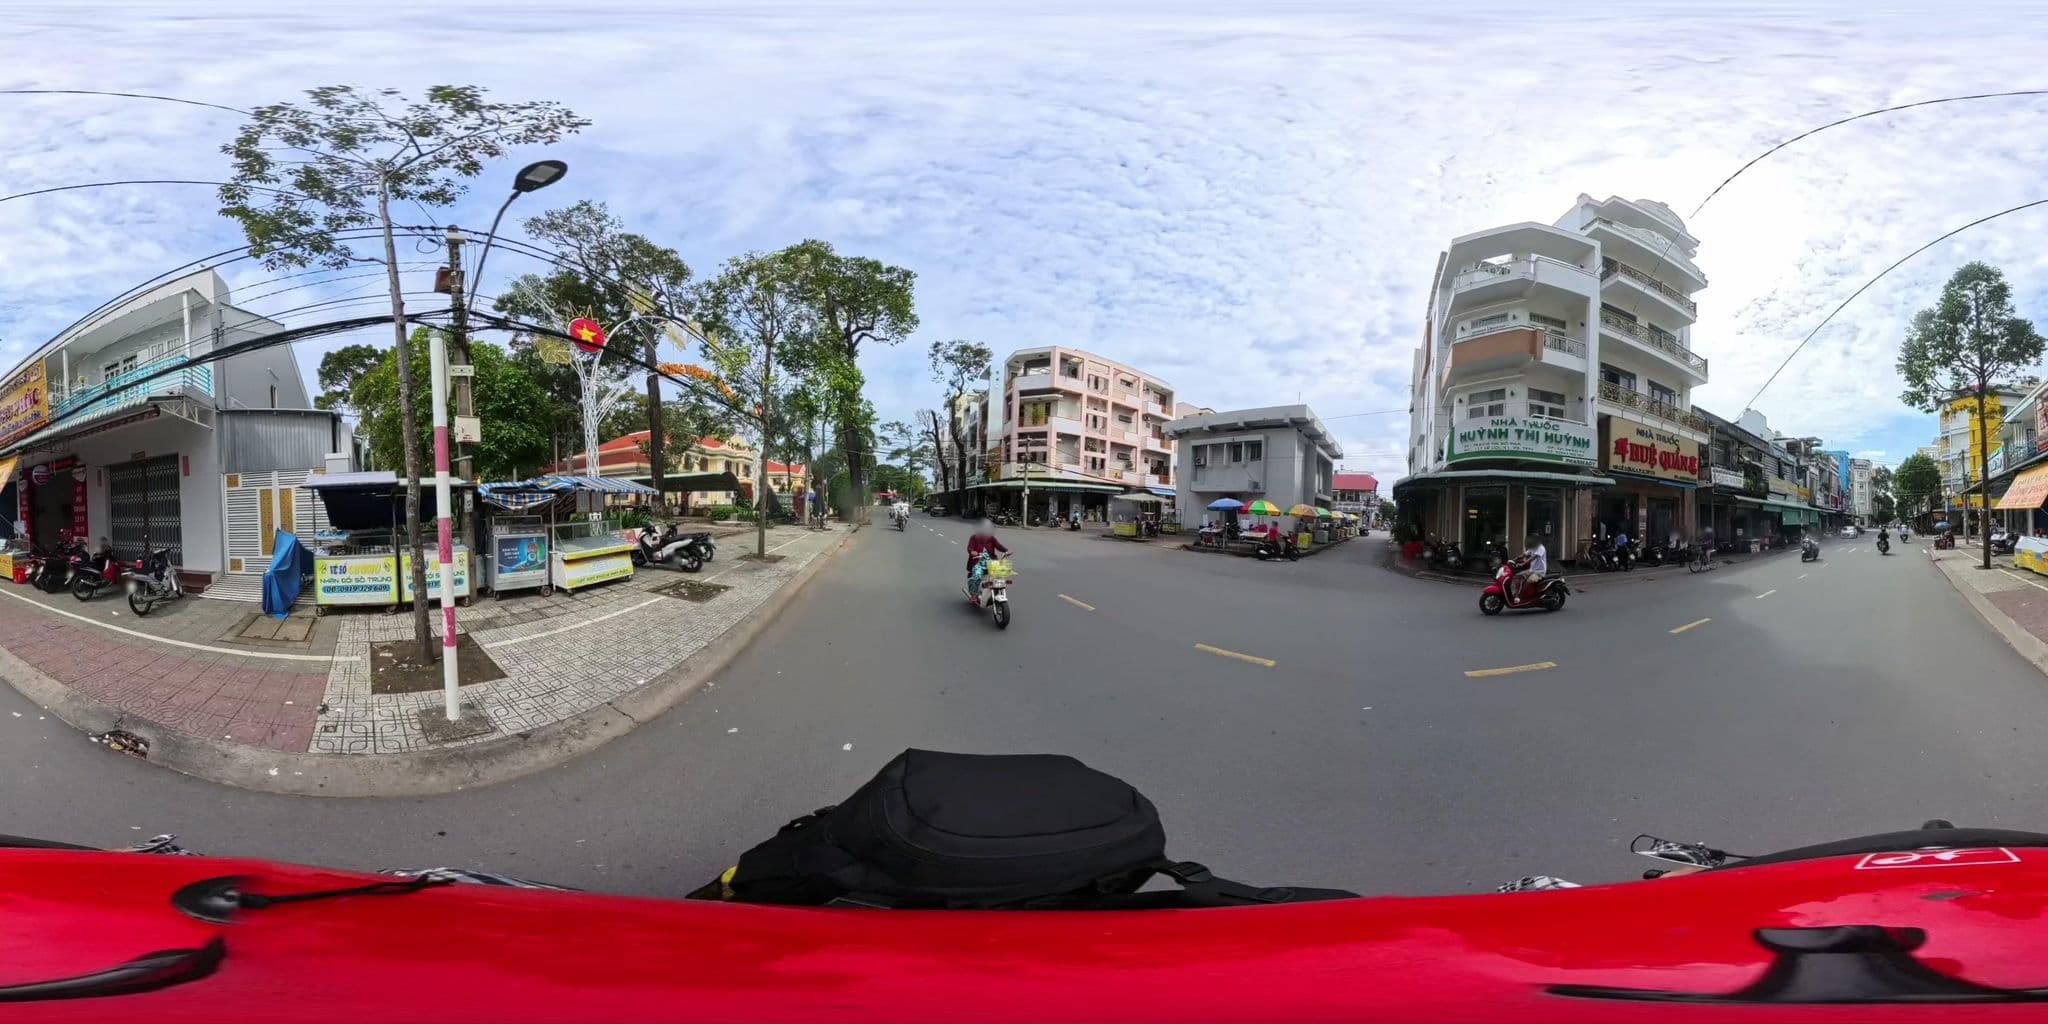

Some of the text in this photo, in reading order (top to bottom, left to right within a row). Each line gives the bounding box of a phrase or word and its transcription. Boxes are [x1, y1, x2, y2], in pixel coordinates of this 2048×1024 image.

[1491, 417, 1560, 431] NHÀ THUỐC
[1460, 427, 1590, 449] HUỲNH THỊ HUỲNH
